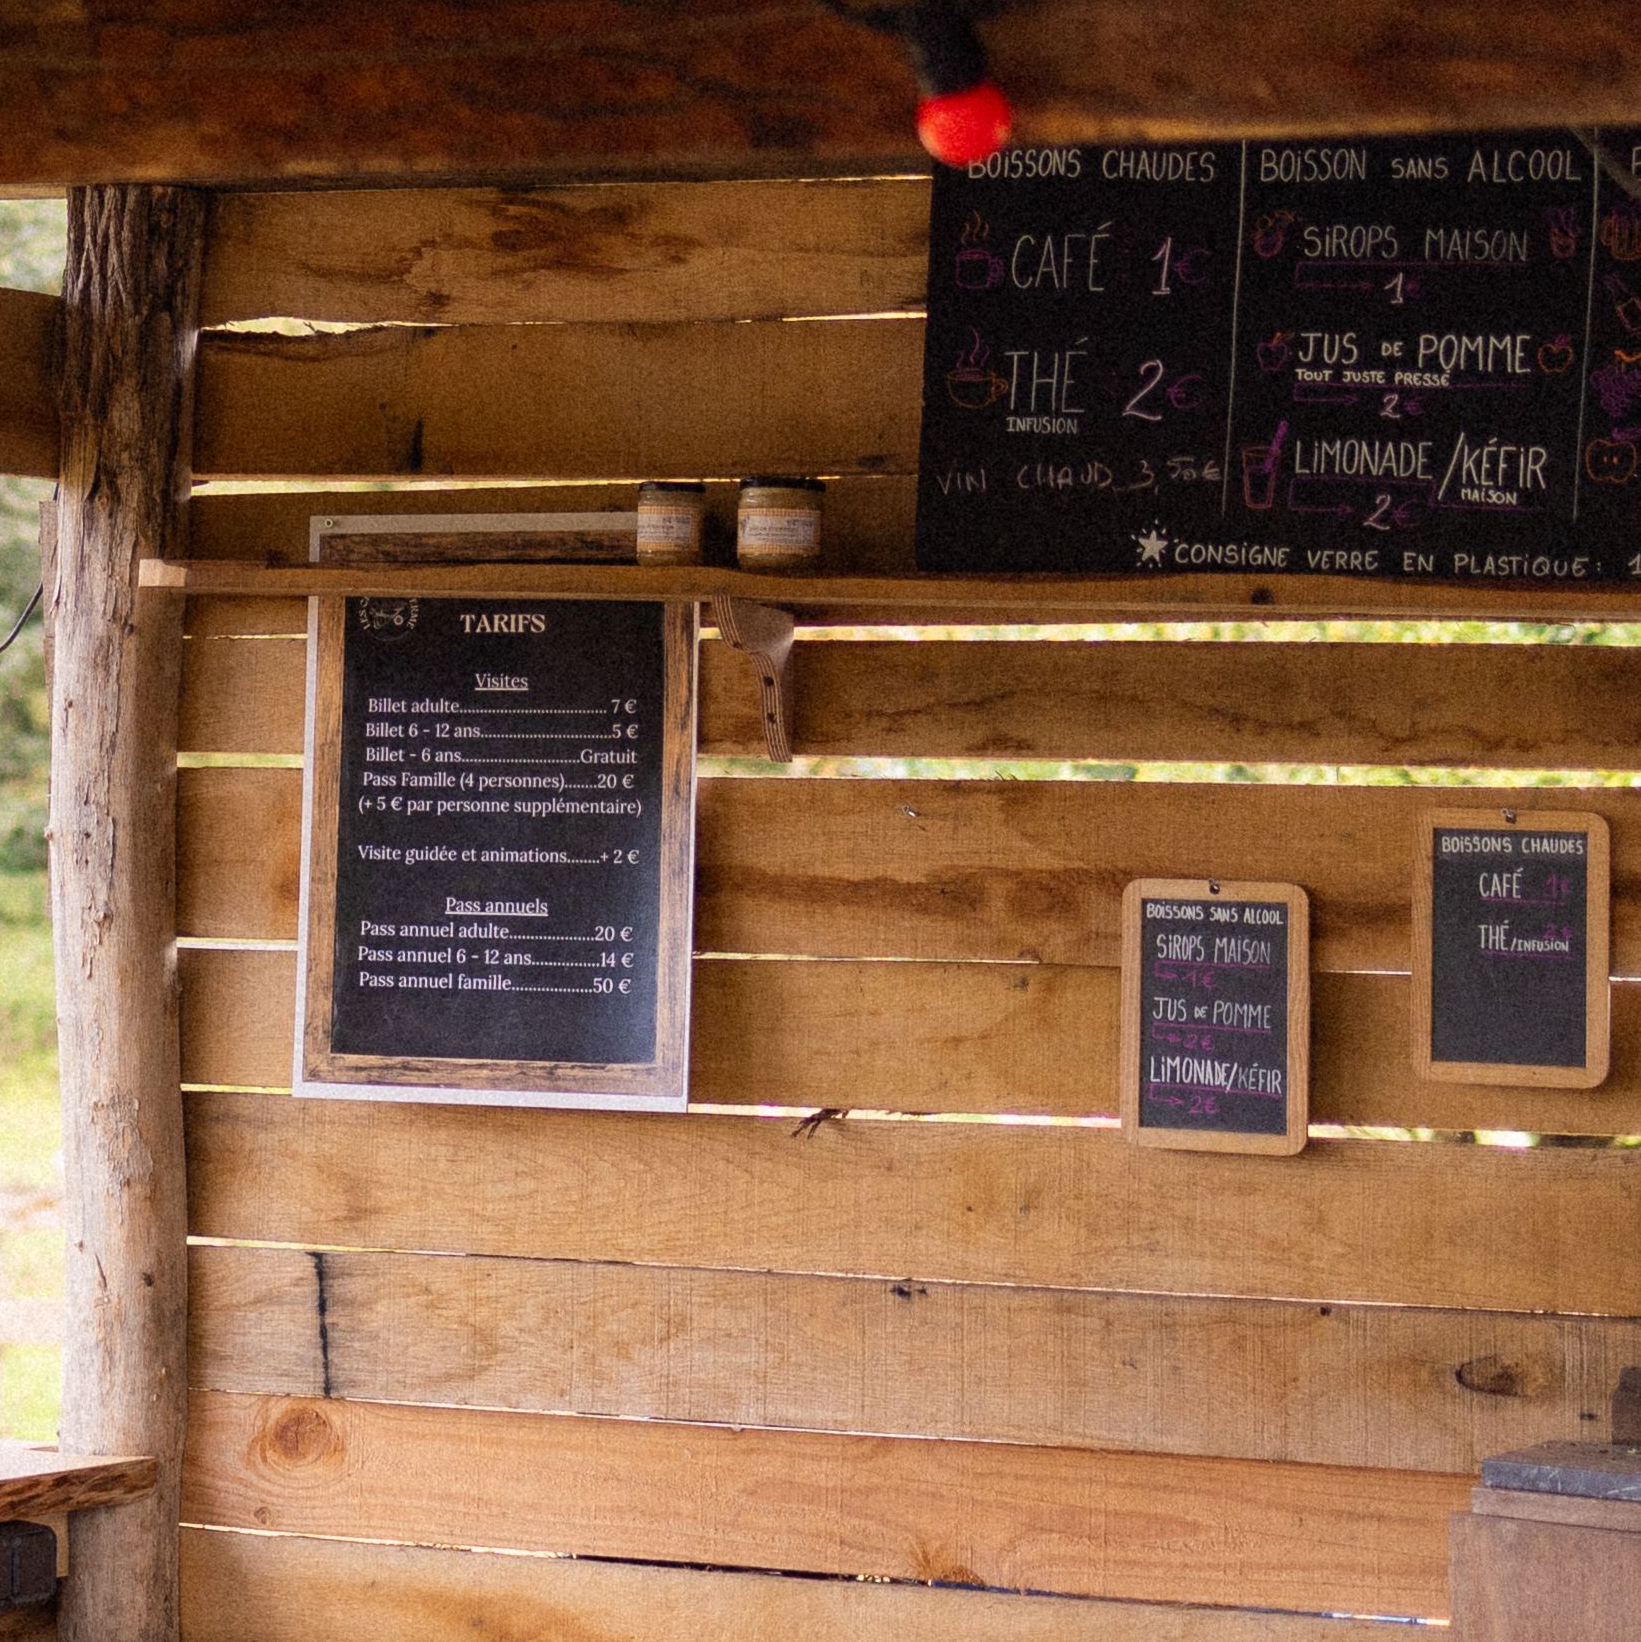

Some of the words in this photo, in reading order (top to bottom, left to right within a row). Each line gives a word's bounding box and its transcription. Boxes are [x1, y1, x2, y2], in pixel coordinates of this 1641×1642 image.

[1102, 150, 1216, 183] CHAUDES
[1391, 158, 1449, 181] SANS
[1467, 149, 1582, 183] ALCOOL
[1011, 221, 1113, 292] CAFÉ
[1298, 333, 1359, 365] JUS
[1381, 341, 1404, 358] DE
[1418, 334, 1532, 374] POMME
[1005, 337, 1089, 413] THÉ
[1295, 369, 1333, 383] TOUT
[1342, 370, 1386, 385] JUSTE
[1006, 415, 1078, 435] INFUSION
[1307, 549, 1380, 572] VERRE
[1403, 551, 1434, 574] EN
[459, 613, 547, 634] TARIFS
[474, 672, 530, 690] Visites
[367, 697, 408, 714] Billet
[610, 699, 621, 715] 7
[624, 699, 638, 715] €
[365, 722, 405, 739] Billet
[408, 723, 419, 739] 6
[435, 723, 451, 739] 12
[611, 724, 622, 740] 5
[626, 724, 639, 740] €
[366, 747, 405, 763] Billet
[420, 747, 431, 763] 6
[580, 748, 638, 765] Gratuit
[362, 771, 397, 787] Pass
[400, 771, 456, 788] Famille
[459, 772, 474, 791] (4
[597, 773, 617, 789] 20
[622, 774, 635, 789] €
[376, 796, 386, 812] 5
[390, 796, 403, 812] €
[407, 800, 433, 816] par
[436, 799, 509, 816] personne
[513, 797, 643, 819] supplémentaire)
[357, 845, 401, 861] Visite
[404, 845, 457, 866] guidée
[461, 848, 477, 862] et
[613, 848, 623, 864] 2
[626, 849, 640, 865] €
[1521, 837, 1584, 856] CHAUDES
[1478, 867, 1524, 899] CAFÉ
[445, 896, 482, 914] Pass
[485, 898, 549, 916] annuels
[1209, 906, 1239, 923] SANS
[1243, 907, 1284, 925] ALCOOL
[360, 920, 396, 936] Pass
[399, 922, 455, 938] annuel
[594, 925, 615, 942] 20
[620, 926, 633, 942] €
[357, 945, 394, 962] Pass
[397, 947, 452, 964] annuel
[456, 948, 467, 964] 6
[484, 949, 500, 965] 12
[599, 951, 617, 968] 14
[621, 952, 635, 968] €
[358, 971, 394, 987] Pass
[398, 973, 453, 989] annuel
[592, 977, 614, 994] 50
[618, 978, 632, 994] €
[1152, 996, 1187, 1022] JUS
[1193, 1005, 1208, 1019] DE
[1212, 999, 1272, 1029] POMME
